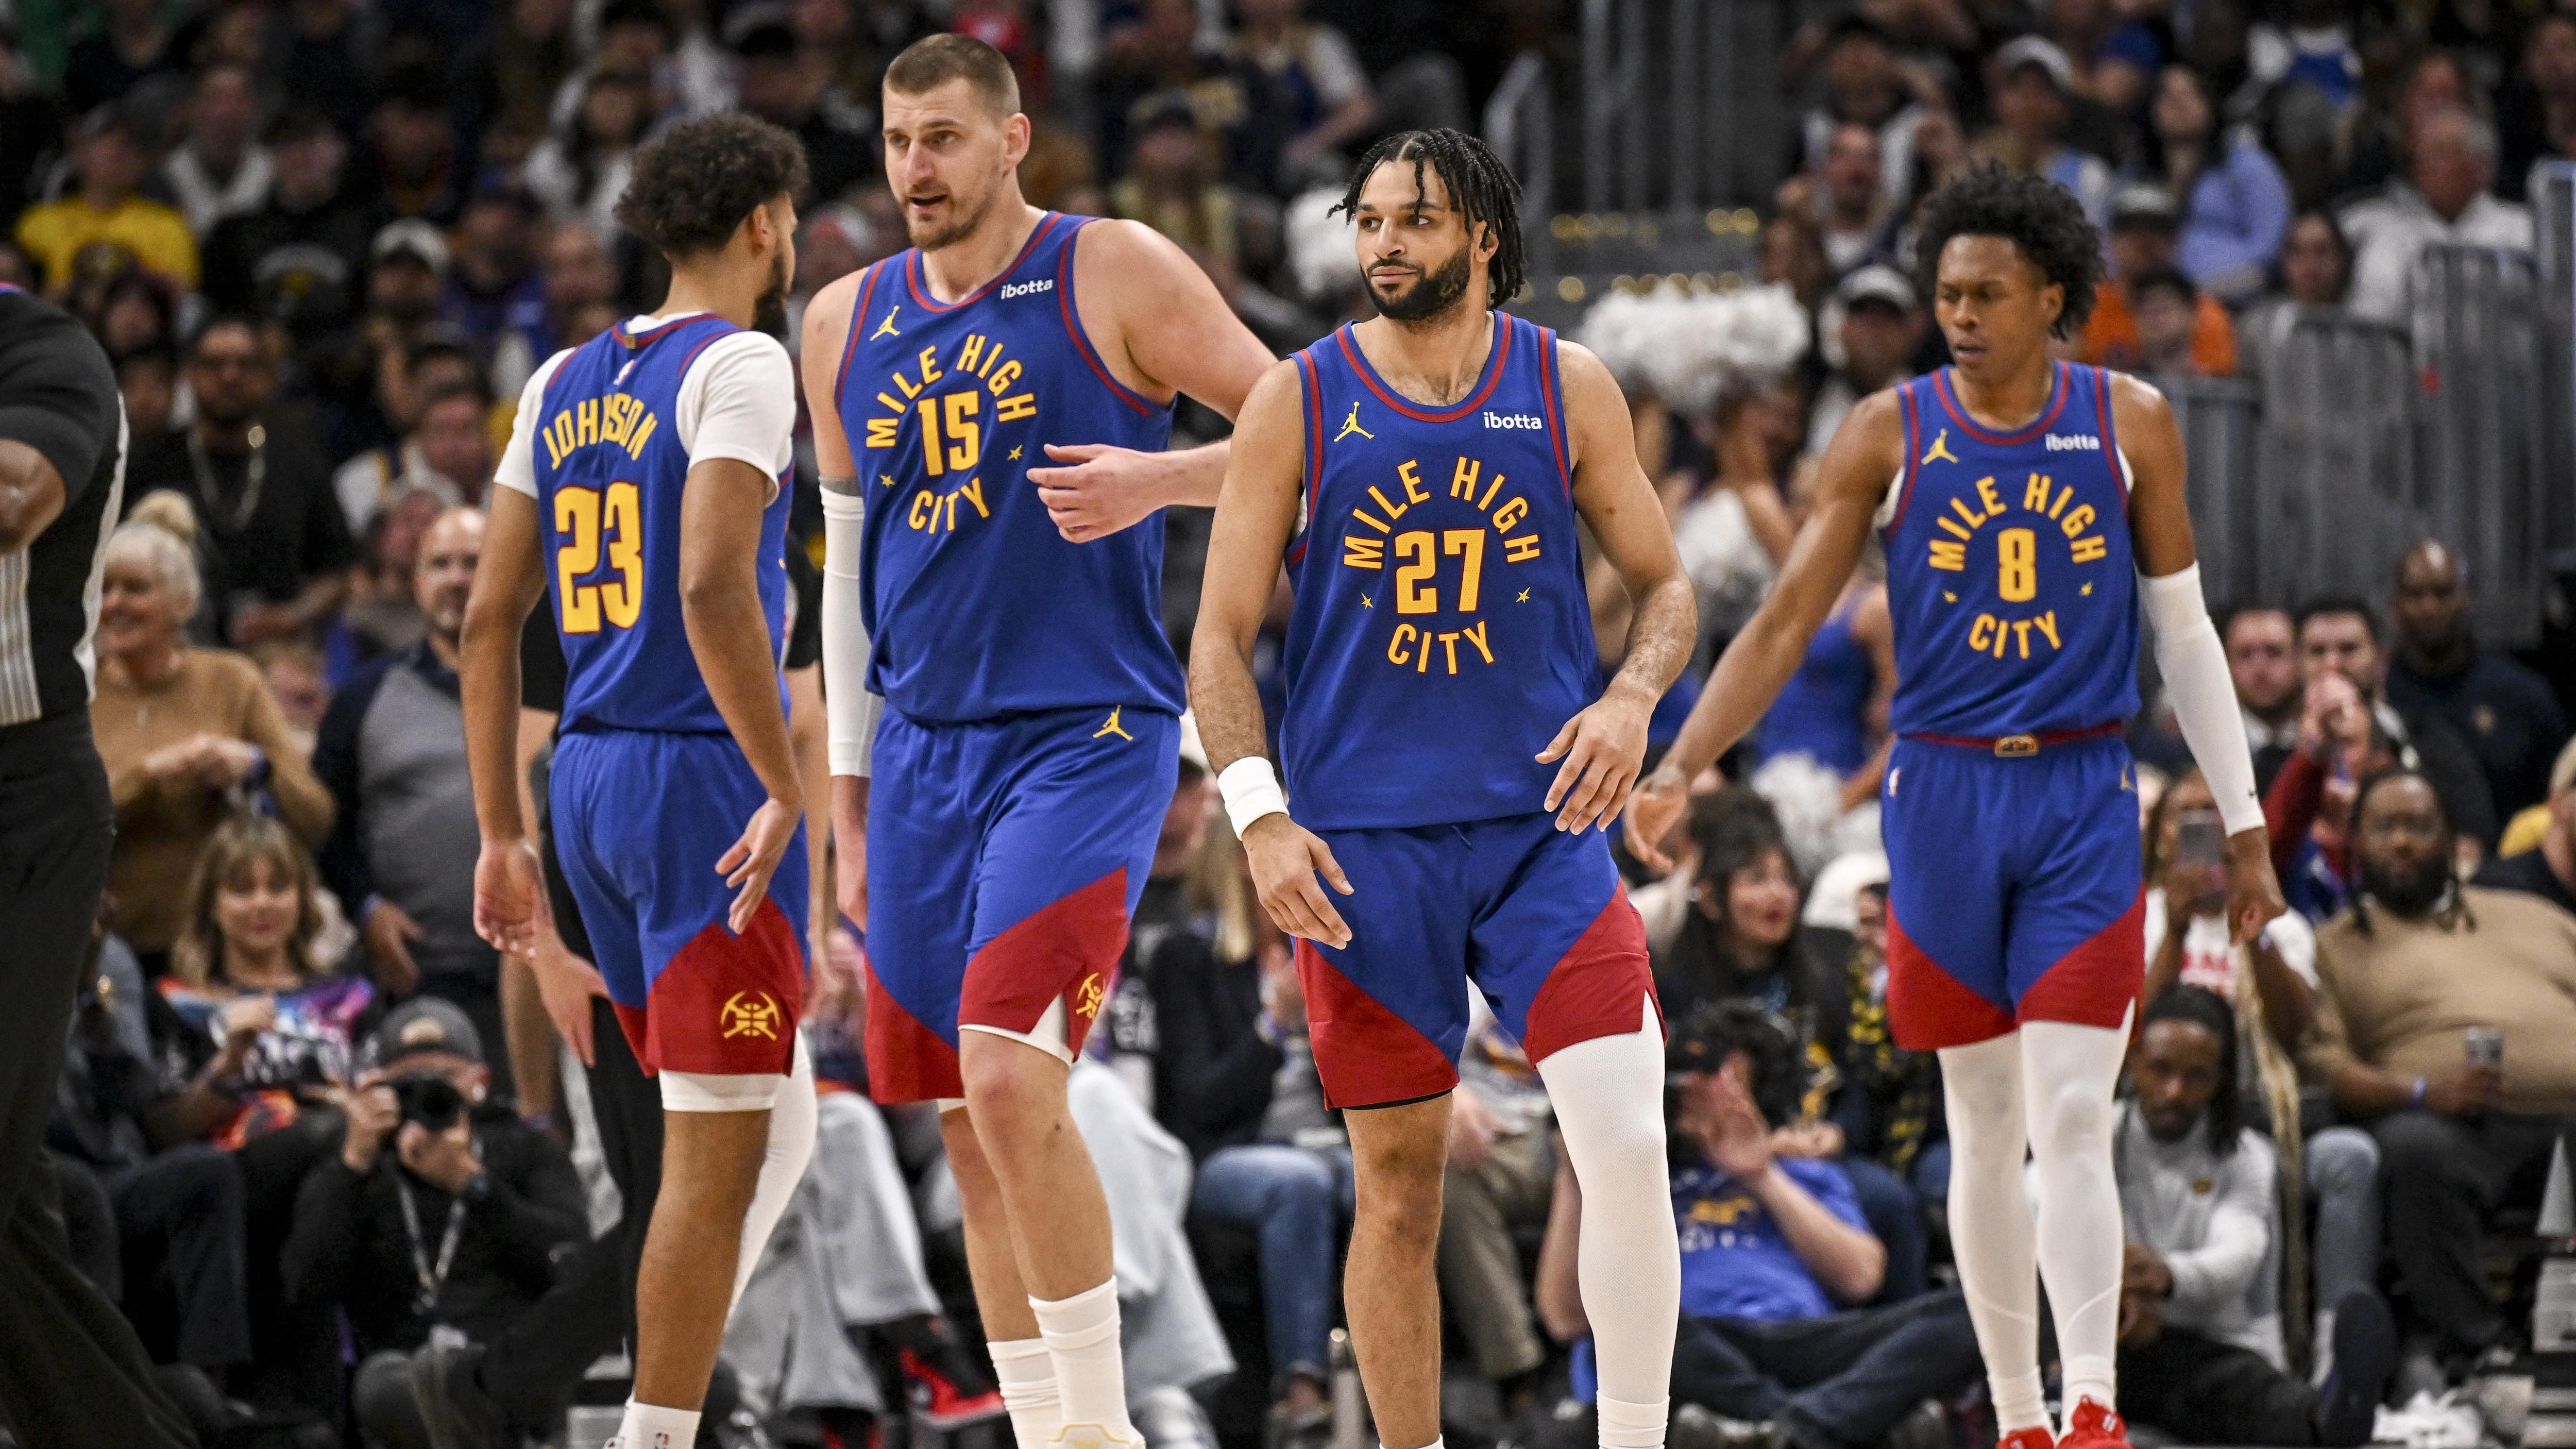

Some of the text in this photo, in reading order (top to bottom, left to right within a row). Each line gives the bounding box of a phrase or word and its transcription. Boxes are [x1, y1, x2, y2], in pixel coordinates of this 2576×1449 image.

[1001, 278, 1053, 300] ibotta
[866, 334, 1038, 447] MILE HIGH
[1483, 412, 1543, 430] ibotta
[917, 390, 979, 477] 15
[2045, 433, 2100, 451] ibotta
[908, 477, 990, 534] CITY
[1343, 455, 1540, 569] MILE HIGH
[1928, 473, 2107, 571] MILE HIGH
[554, 480, 643, 634] 23
[1395, 527, 1485, 614] 27
[1997, 527, 2036, 602] 8
[1387, 619, 1495, 675] CITY
[1969, 609, 2061, 659] CITY
